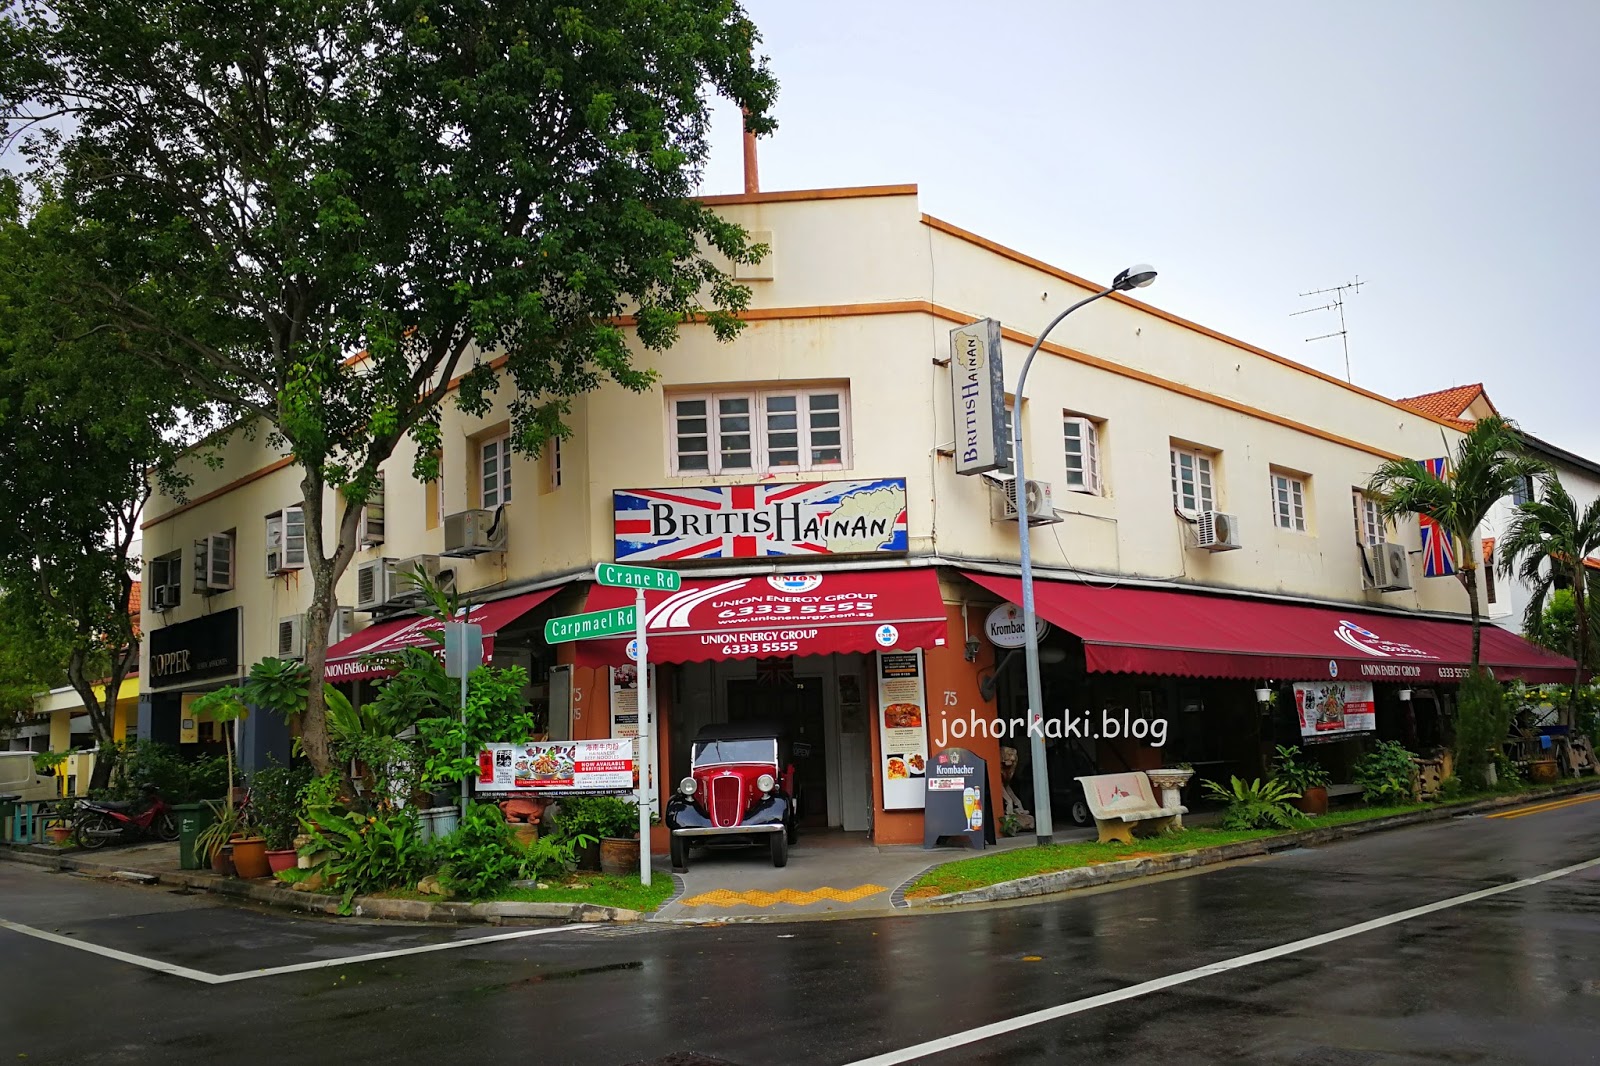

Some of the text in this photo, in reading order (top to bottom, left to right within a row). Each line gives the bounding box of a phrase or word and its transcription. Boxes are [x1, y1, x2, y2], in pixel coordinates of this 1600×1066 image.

[606, 566, 674, 588] Crane Rd
[712, 592, 878, 609] UNION ENERGY GROUP
[717, 602, 873, 619] 6333 5555
[717, 612, 874, 625] www.unionenergy.com.sg
[552, 609, 633, 637] Carpmael Rd
[990, 621, 1039, 636] Krombacr
[701, 629, 818, 645] UNION ENERGY GROUP
[722, 641, 798, 655] 6333 5555
[150, 649, 190, 677] COPPER
[1360, 664, 1420, 677] UNION ENERGY GROUP
[1438, 667, 1454, 678] 6333
[943, 690, 957, 706] 75
[936, 764, 974, 775] Krombacher
